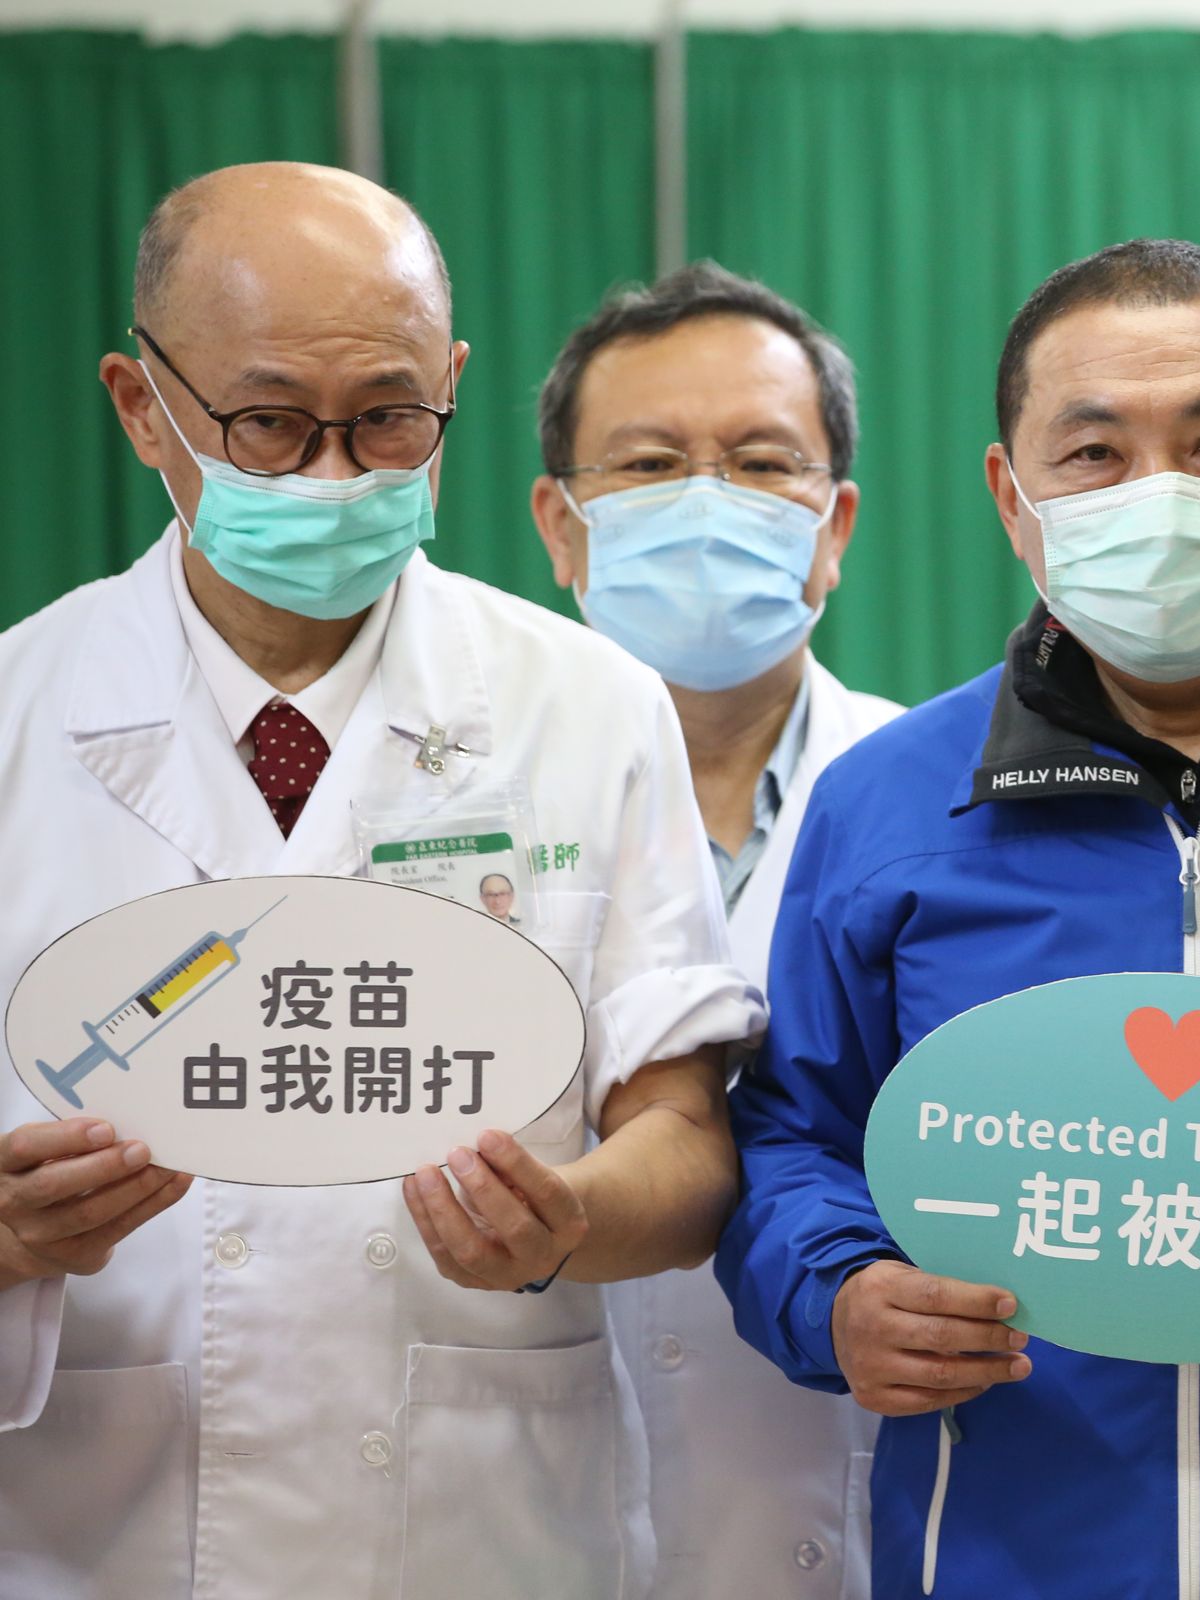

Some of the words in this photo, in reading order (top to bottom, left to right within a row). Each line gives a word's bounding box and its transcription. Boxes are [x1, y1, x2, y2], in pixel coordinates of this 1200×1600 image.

[992, 769, 1050, 790] HELLY
[1055, 766, 1139, 786] HANSEN
[261, 960, 413, 1029] 疫苗
[183, 1043, 495, 1114] 由我開打
[918, 1101, 1168, 1160] Protected
